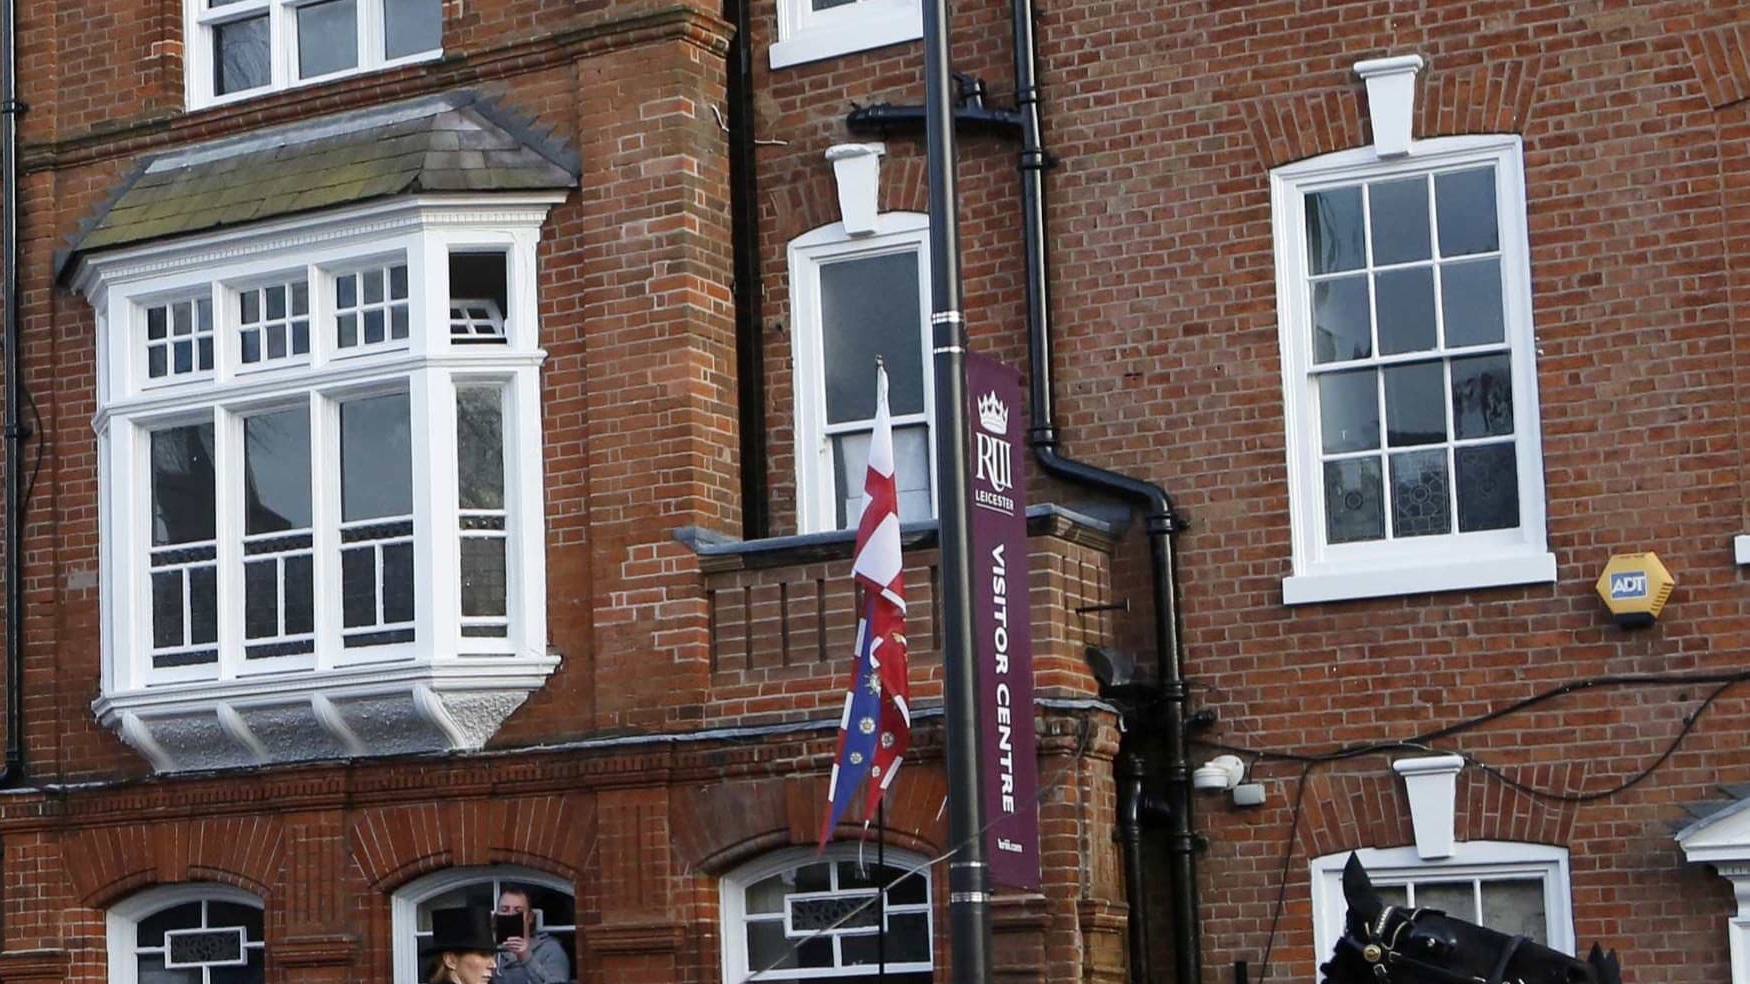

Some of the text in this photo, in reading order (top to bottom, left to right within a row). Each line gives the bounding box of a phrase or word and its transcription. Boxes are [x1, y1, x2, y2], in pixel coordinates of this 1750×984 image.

[975, 489, 1014, 511] LEICESTER
[1612, 575, 1645, 593] ADT
[992, 544, 1015, 814] VISITOR CENTRE
